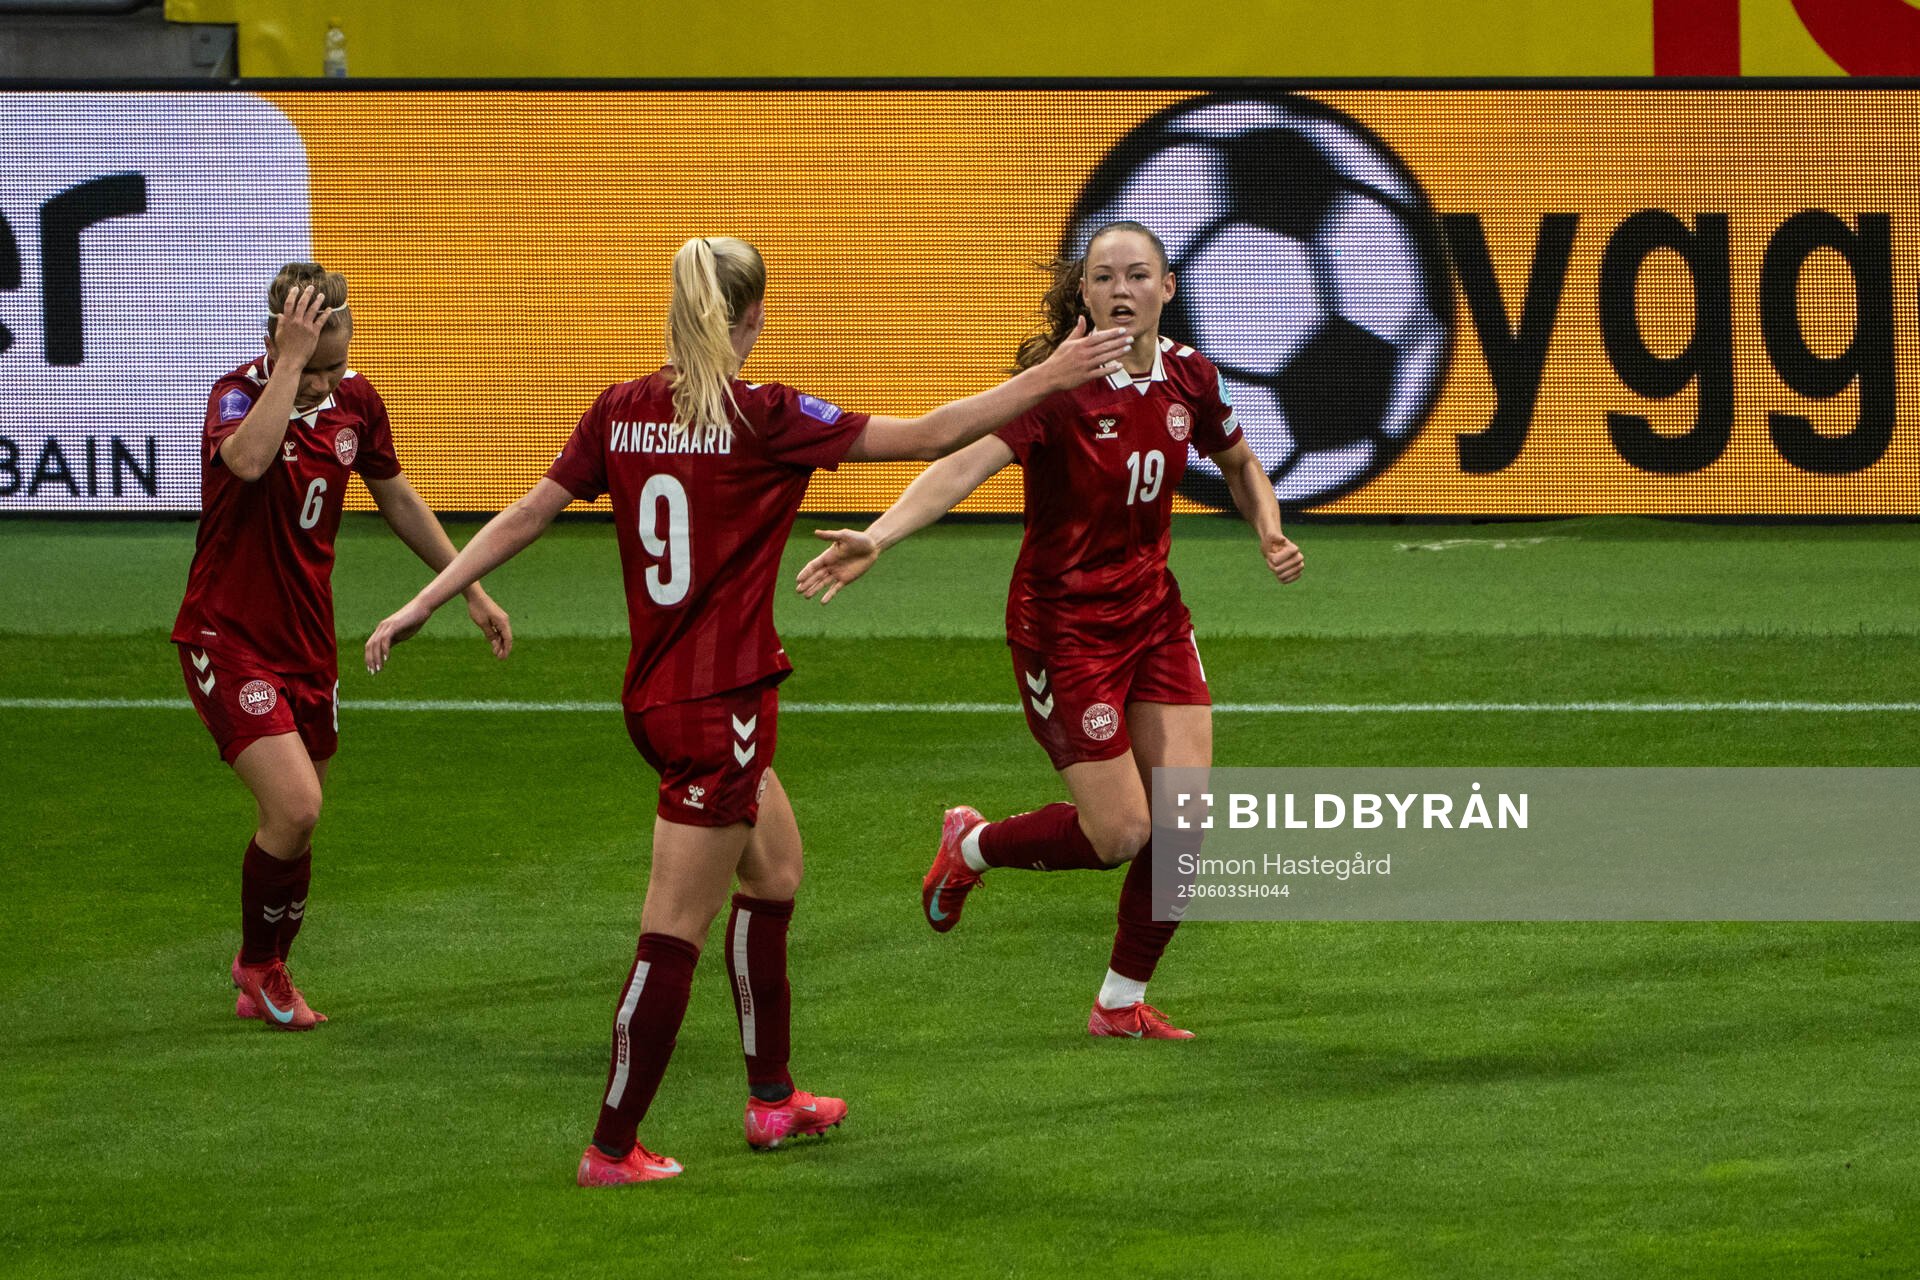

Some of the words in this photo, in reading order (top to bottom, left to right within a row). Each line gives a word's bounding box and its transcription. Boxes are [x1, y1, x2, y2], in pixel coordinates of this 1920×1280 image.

[0, 170, 147, 368] r
[300, 477, 327, 529] 6
[1126, 449, 1165, 505] 19
[638, 473, 691, 606] 9
[246, 690, 269, 704] DBU
[1090, 713, 1112, 730] DBU
